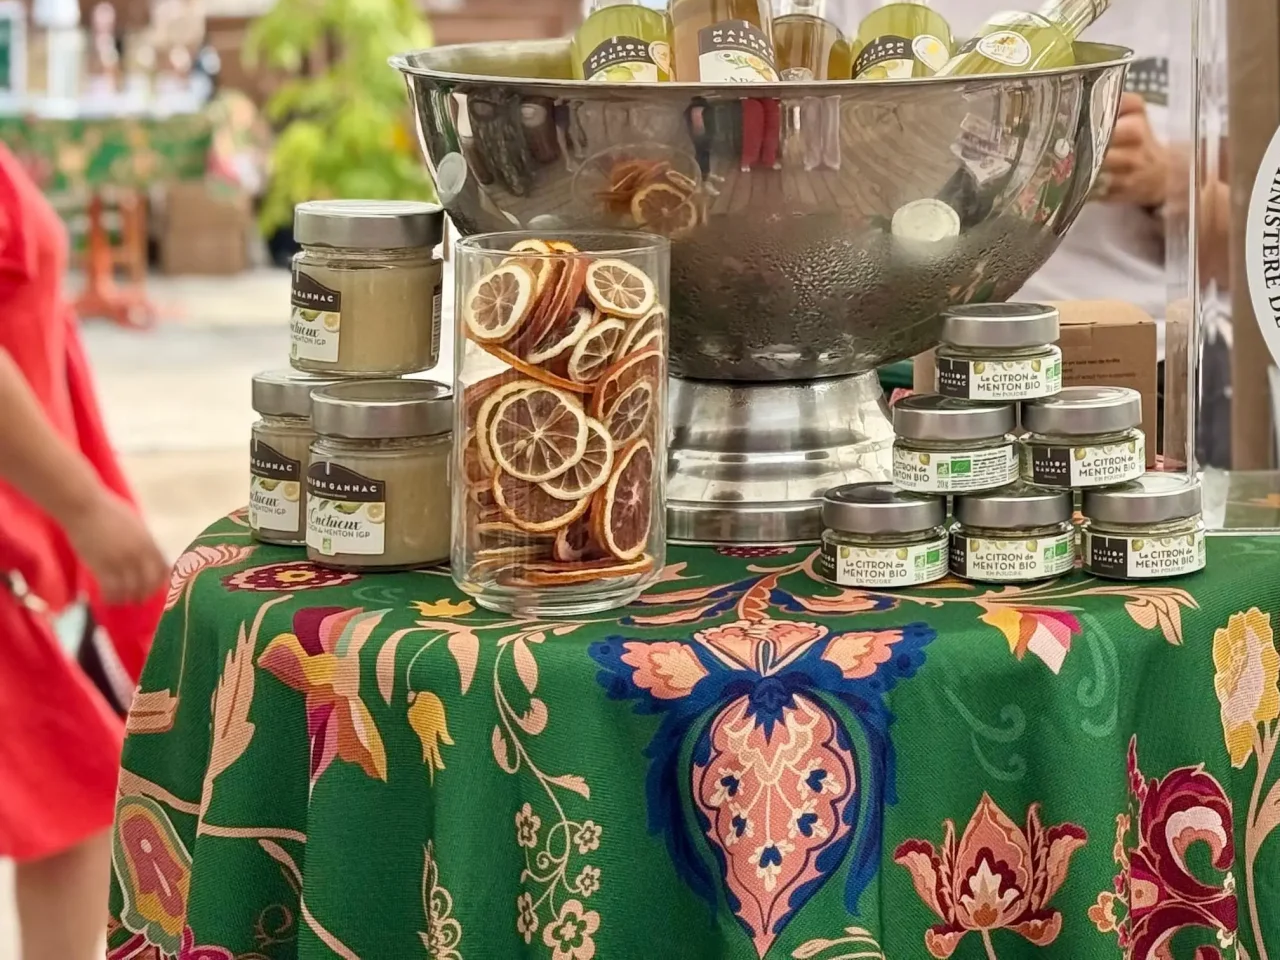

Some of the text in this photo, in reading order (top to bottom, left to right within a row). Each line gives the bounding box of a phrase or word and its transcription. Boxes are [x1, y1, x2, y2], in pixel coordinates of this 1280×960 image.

[590, 44, 645, 62] MAISON
[591, 51, 646, 69] GANNAC
[992, 373, 1028, 382] CITRON
[977, 381, 1040, 391] MENTON BIO
[256, 459, 293, 472] GANNAC
[1093, 456, 1127, 467] CITRON
[1079, 462, 1136, 477] MENTON BIO
[914, 474, 930, 483] BIO
[329, 481, 377, 493] GANNAC
[324, 527, 355, 538] MENTON
[356, 530, 370, 538] IGP
[986, 553, 1023, 561] CITRON
[1150, 548, 1185, 558] CITRON
[856, 560, 893, 569] CITRON
[972, 562, 1015, 570] MENTON
[1136, 556, 1194, 568] MENTON BIO
[843, 569, 907, 578] MENTON BIO
